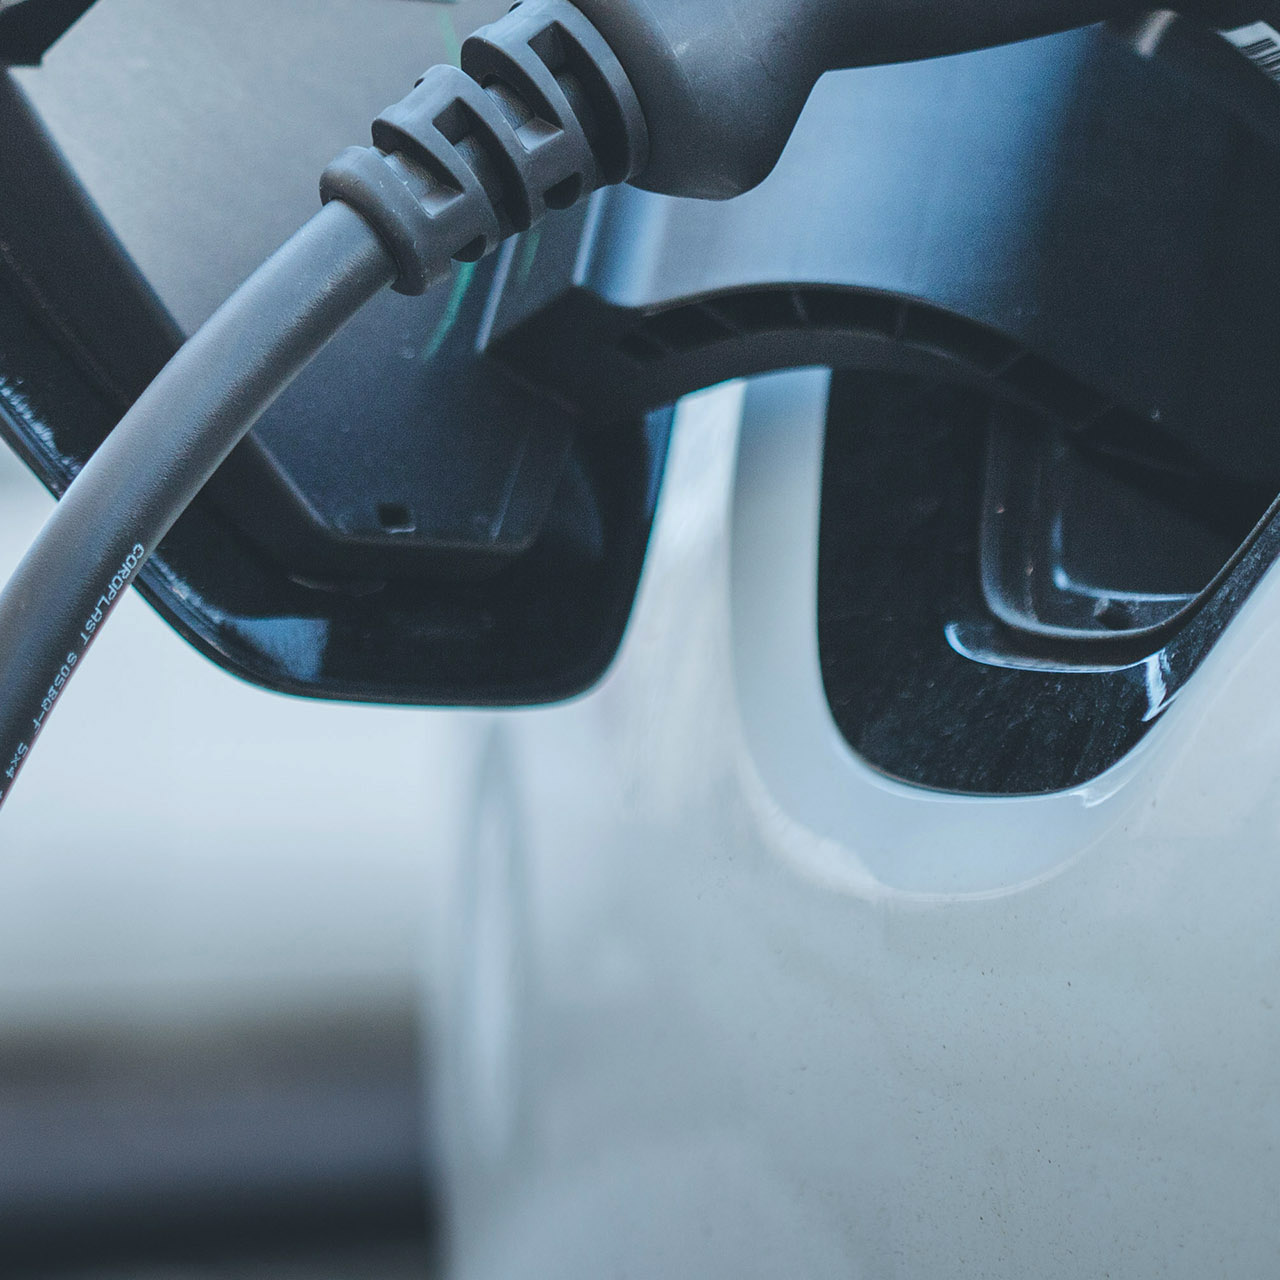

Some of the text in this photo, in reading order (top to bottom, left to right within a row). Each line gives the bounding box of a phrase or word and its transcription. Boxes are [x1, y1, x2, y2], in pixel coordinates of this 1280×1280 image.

[80, 543, 145, 646] COROPLAST
[33, 651, 78, 735] S05BQ-F
[5, 742, 29, 779] 5x4
